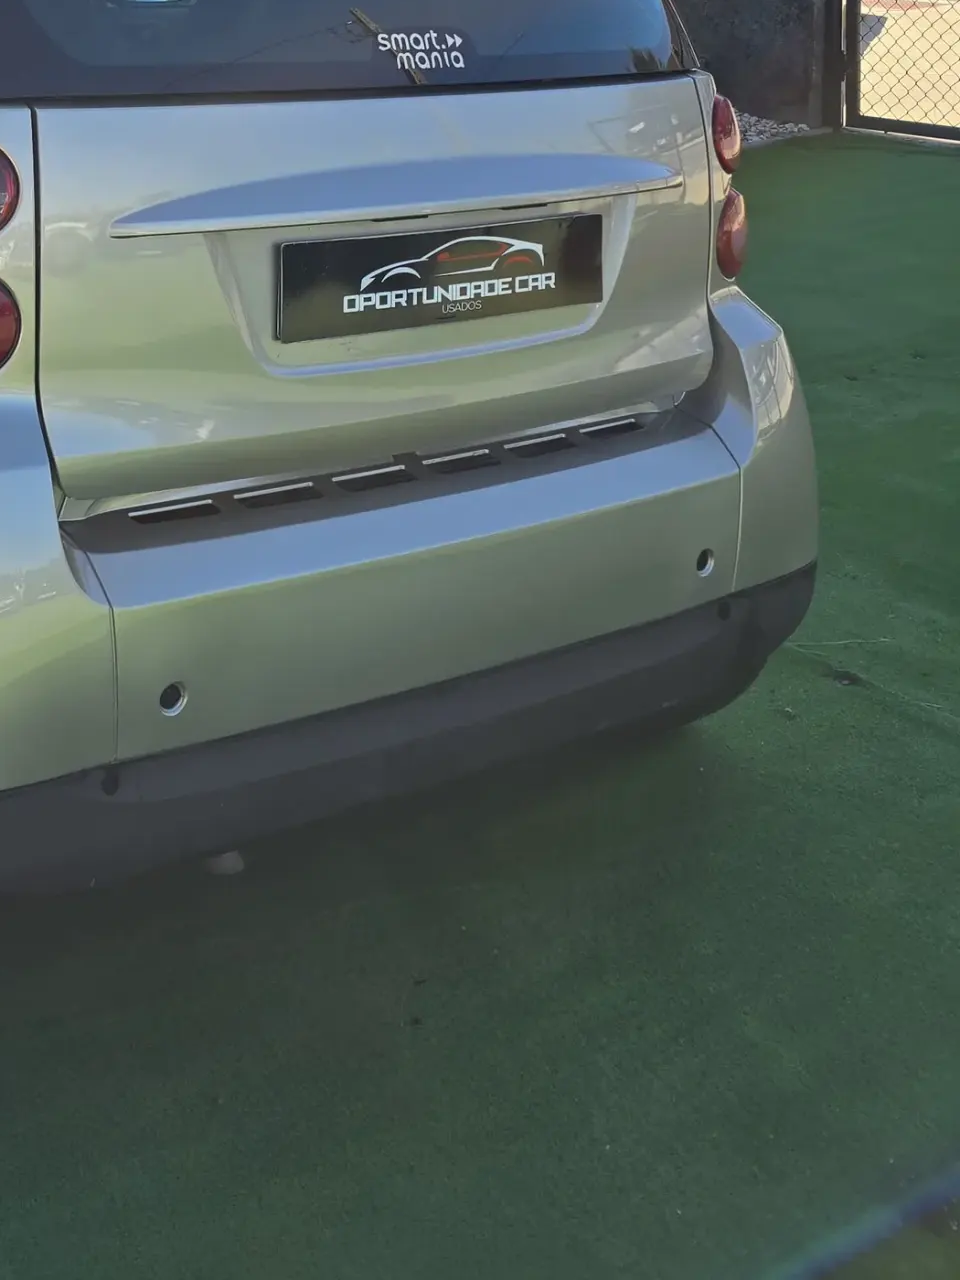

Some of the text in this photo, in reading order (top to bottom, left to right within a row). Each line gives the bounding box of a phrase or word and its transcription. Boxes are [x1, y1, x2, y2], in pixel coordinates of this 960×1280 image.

[396, 45, 465, 70] mania
[342, 272, 556, 314] OPORTUNIDADE CAR
[441, 300, 483, 315] USADOS
